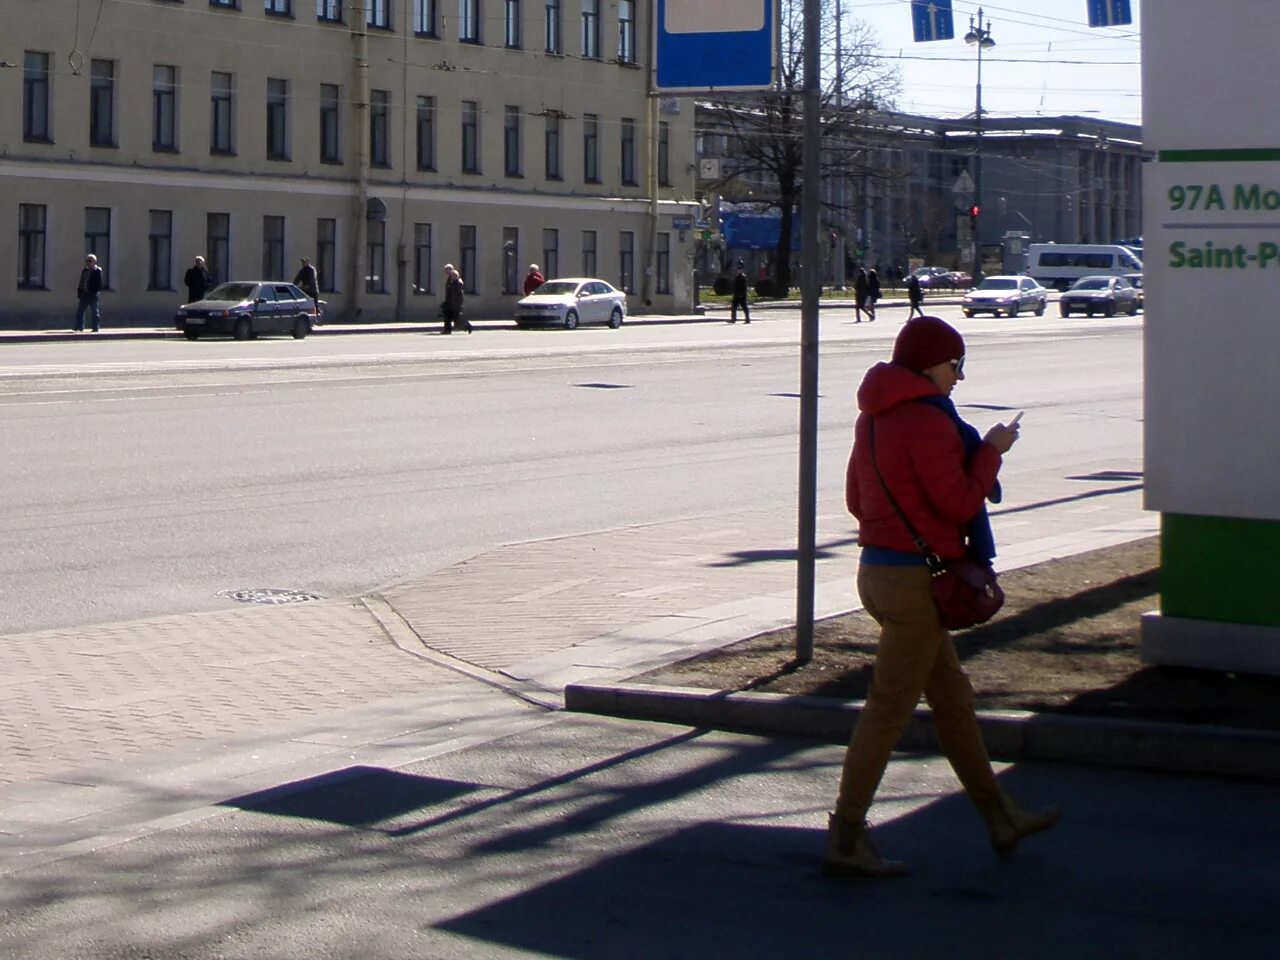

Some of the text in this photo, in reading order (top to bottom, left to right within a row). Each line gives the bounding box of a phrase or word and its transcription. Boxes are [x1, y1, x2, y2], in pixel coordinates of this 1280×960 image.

[1168, 184, 1280, 210] 97A Mo
[1169, 241, 1280, 268] Saint-P
